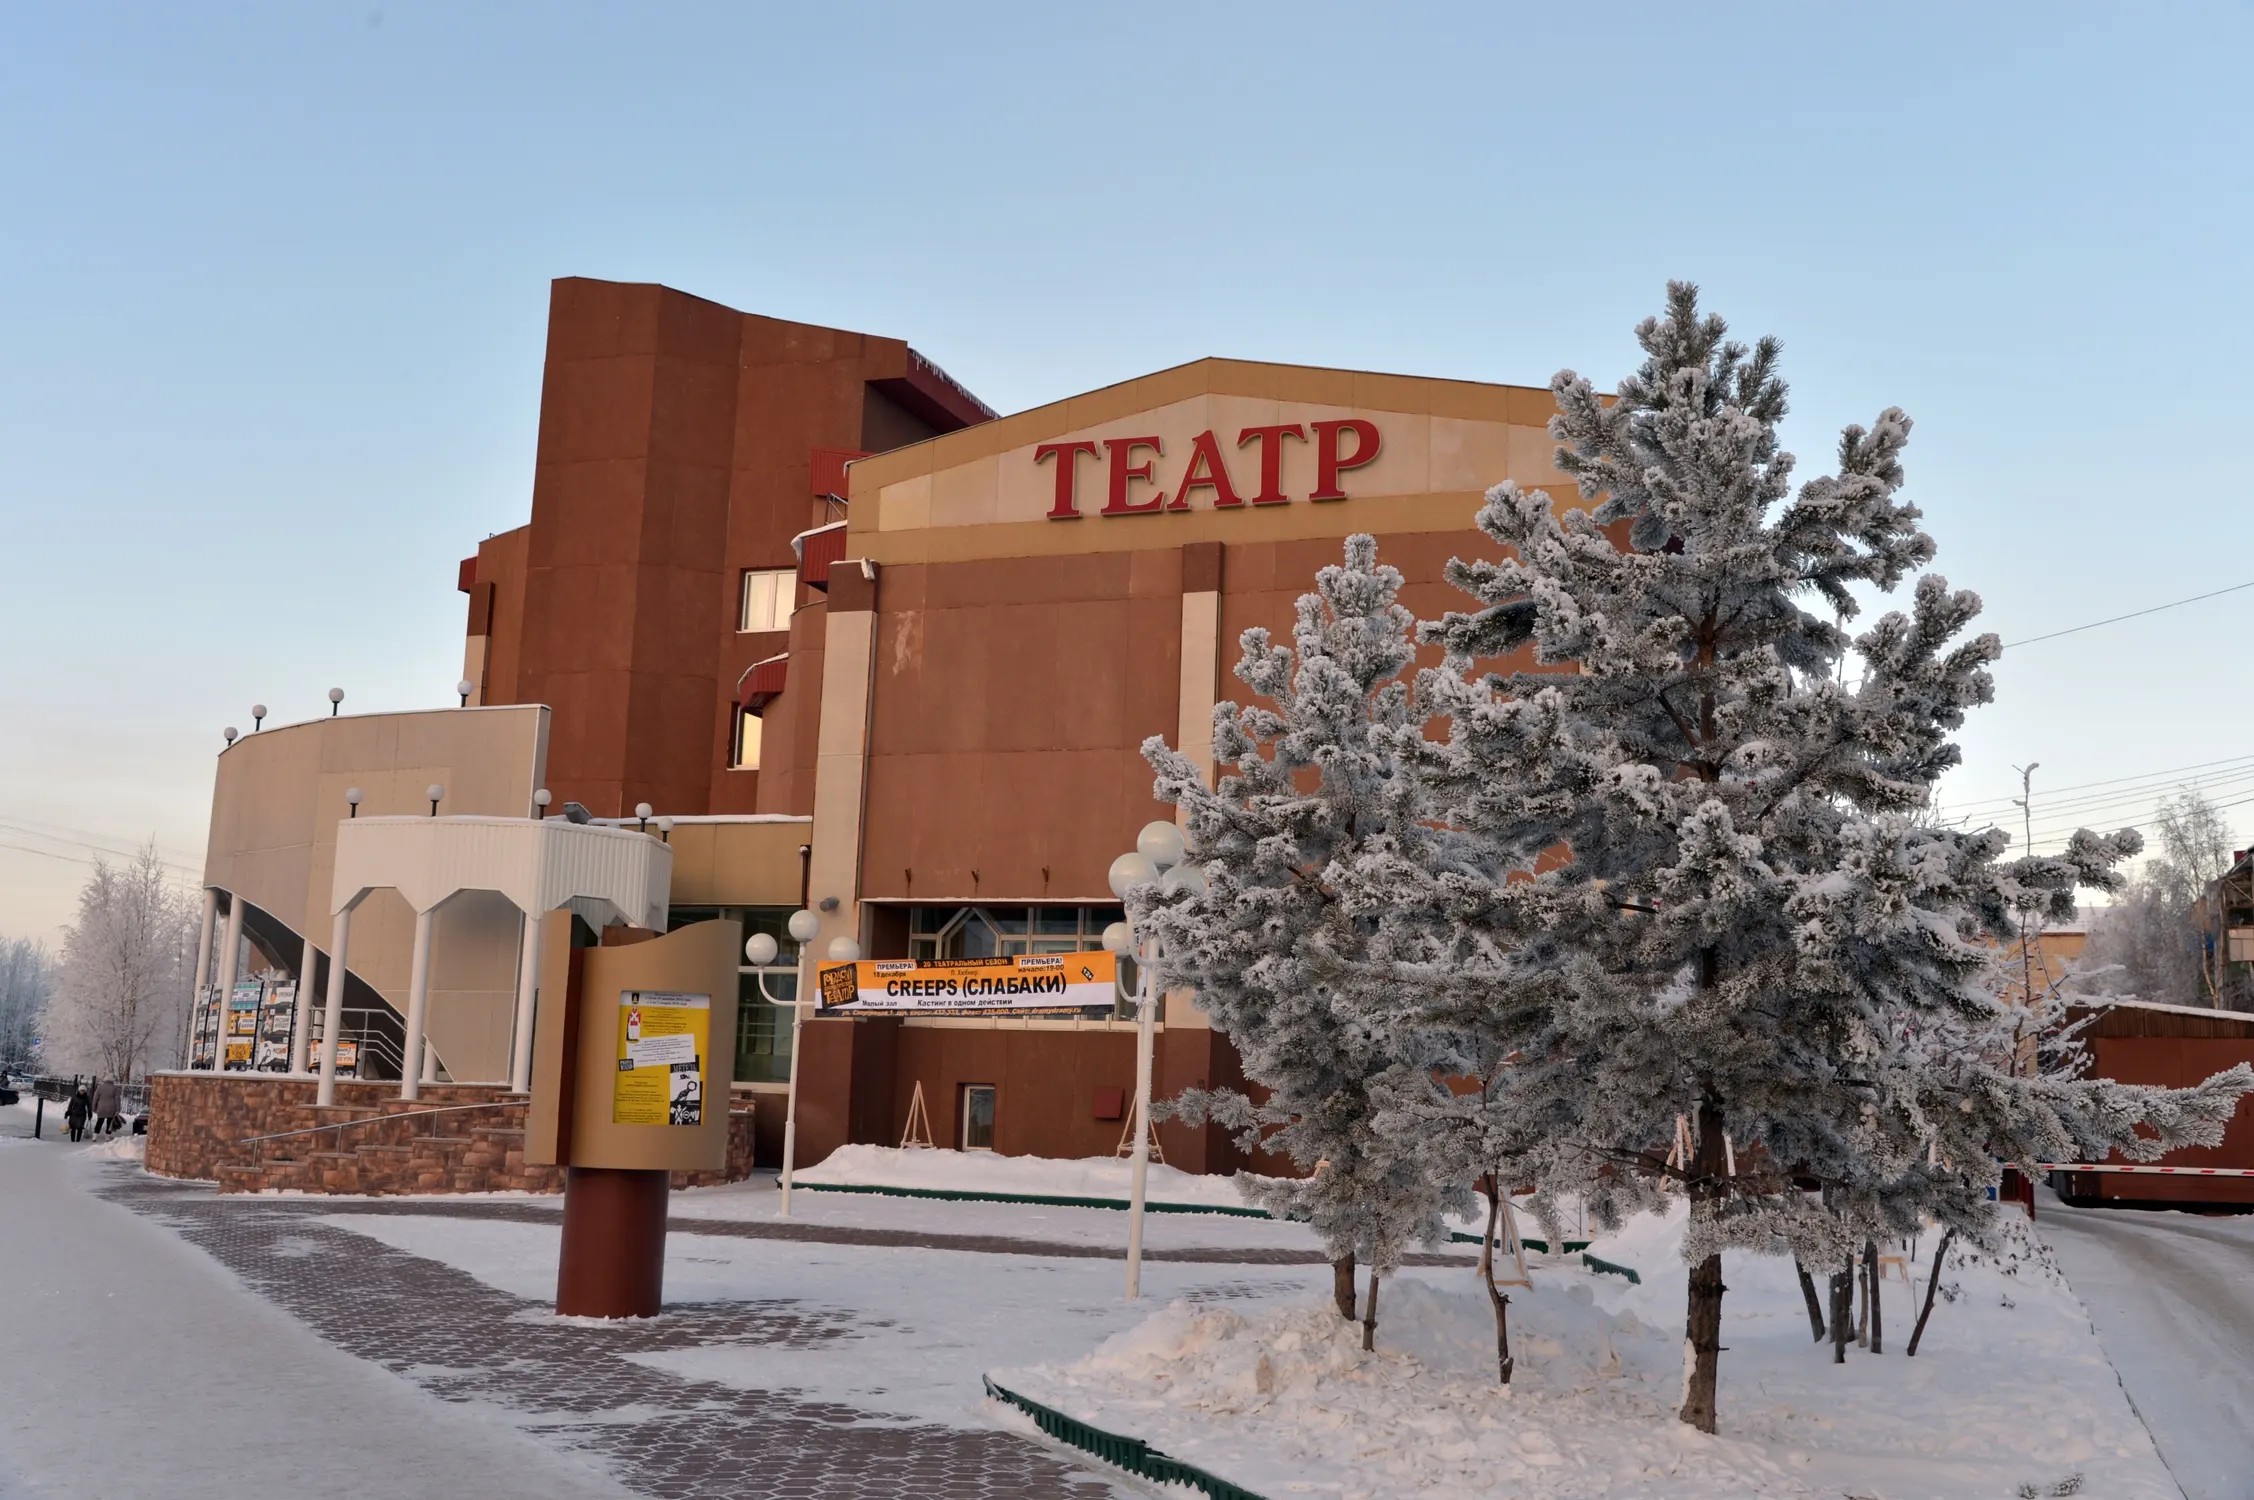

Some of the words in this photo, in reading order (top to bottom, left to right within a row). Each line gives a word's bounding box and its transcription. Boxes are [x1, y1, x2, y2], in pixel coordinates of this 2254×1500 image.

[1033, 418, 1382, 520] ТЕАТР
[877, 962, 914, 970] ПРЕМЬЕРА!
[934, 959, 983, 967] ТЕАТРАЛЬНЫЙ
[984, 958, 1008, 966] СЕЗОН
[1021, 958, 1062, 966] ПРЕМЬЕРА!
[886, 979, 958, 997] CREEPS
[962, 972, 1067, 998] (СЛАБАКИ)
[917, 999, 946, 1007] Кастинг
[977, 998, 1013, 1006] действии
